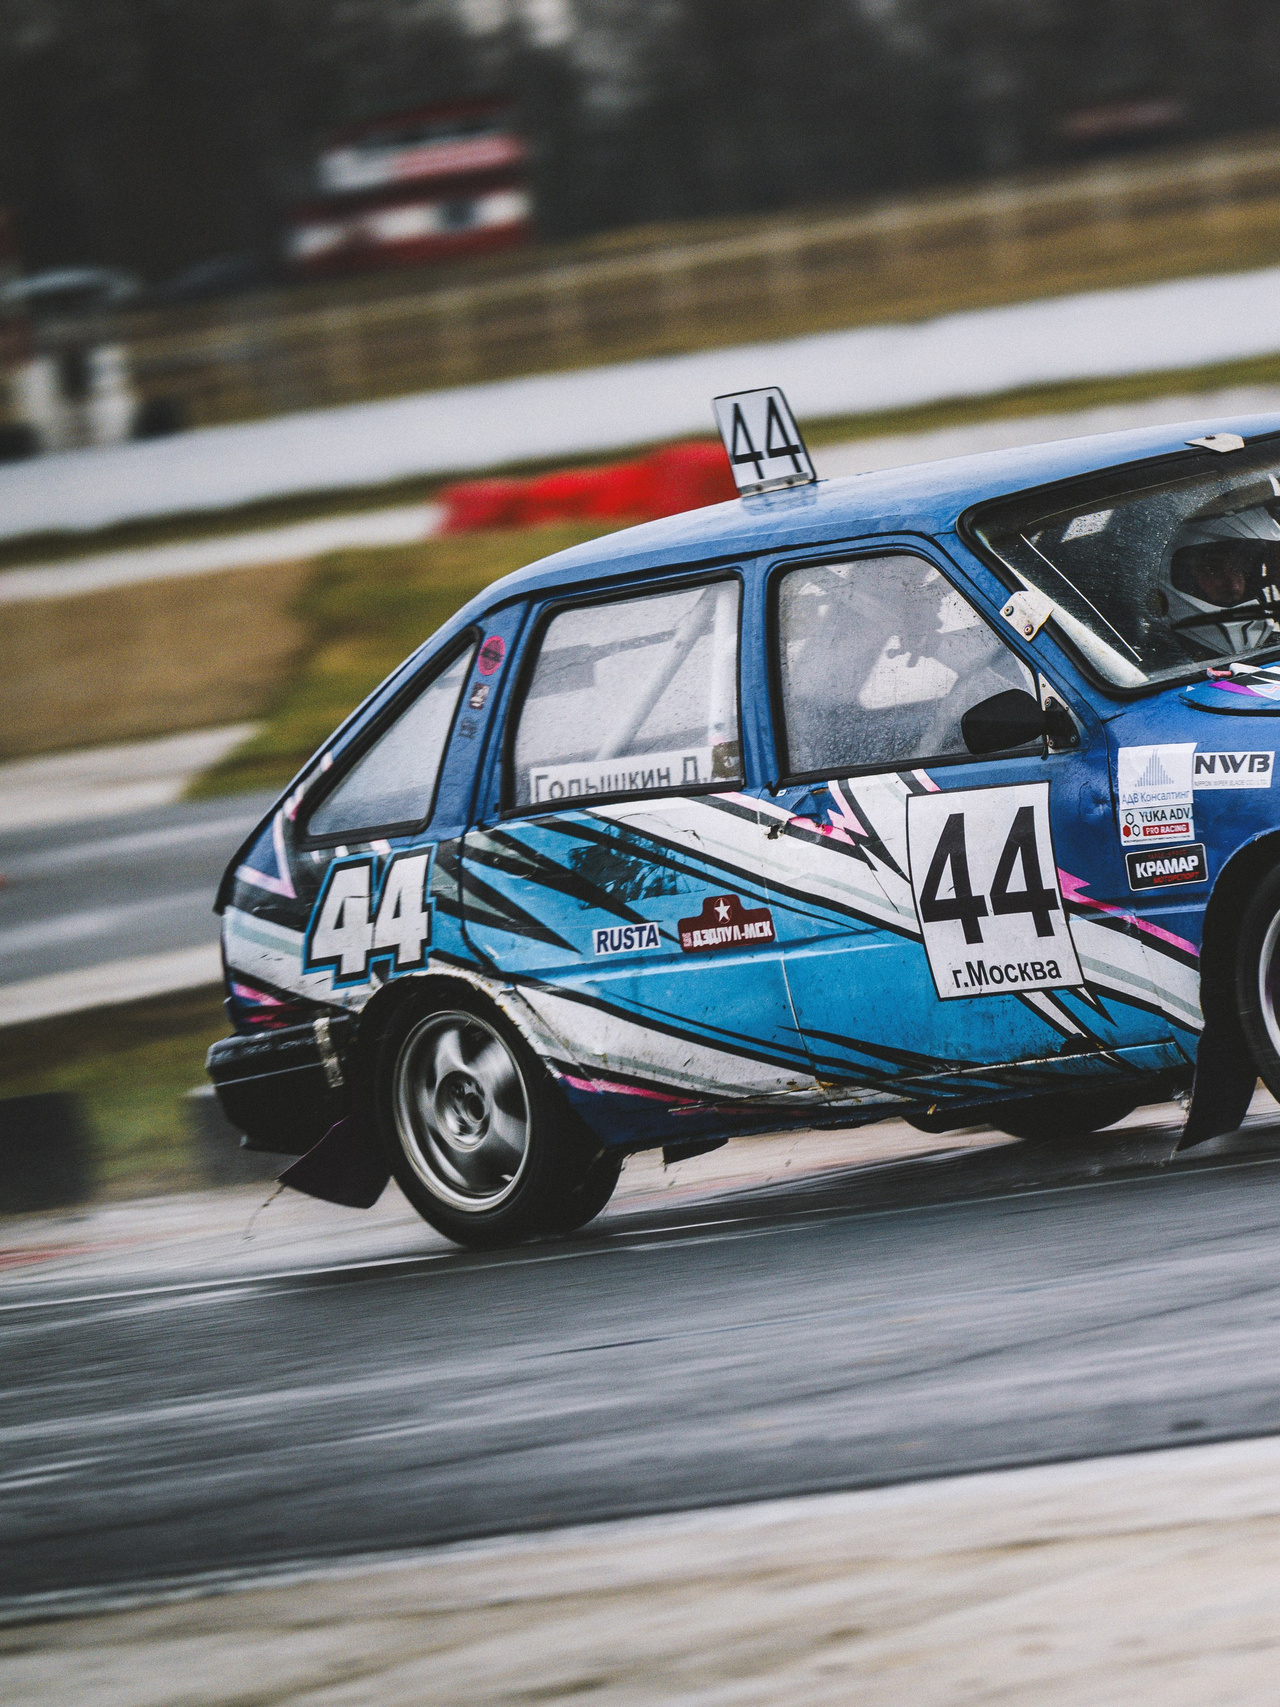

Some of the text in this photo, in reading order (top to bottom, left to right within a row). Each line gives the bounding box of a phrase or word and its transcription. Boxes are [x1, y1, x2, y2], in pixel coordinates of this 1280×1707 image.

[731, 396, 803, 480] 44
[1194, 754, 1271, 775] NWB
[1121, 790, 1191, 806] АДВ Консалтинг
[1139, 807, 1190, 823] YUKA ADV
[1145, 825, 1188, 835] PRO RACING
[918, 805, 1060, 945] 44
[1135, 855, 1199, 879] КРАМАР
[304, 846, 434, 986] 44
[596, 924, 659, 954] RUSTA
[951, 959, 1062, 989] г.Москва
